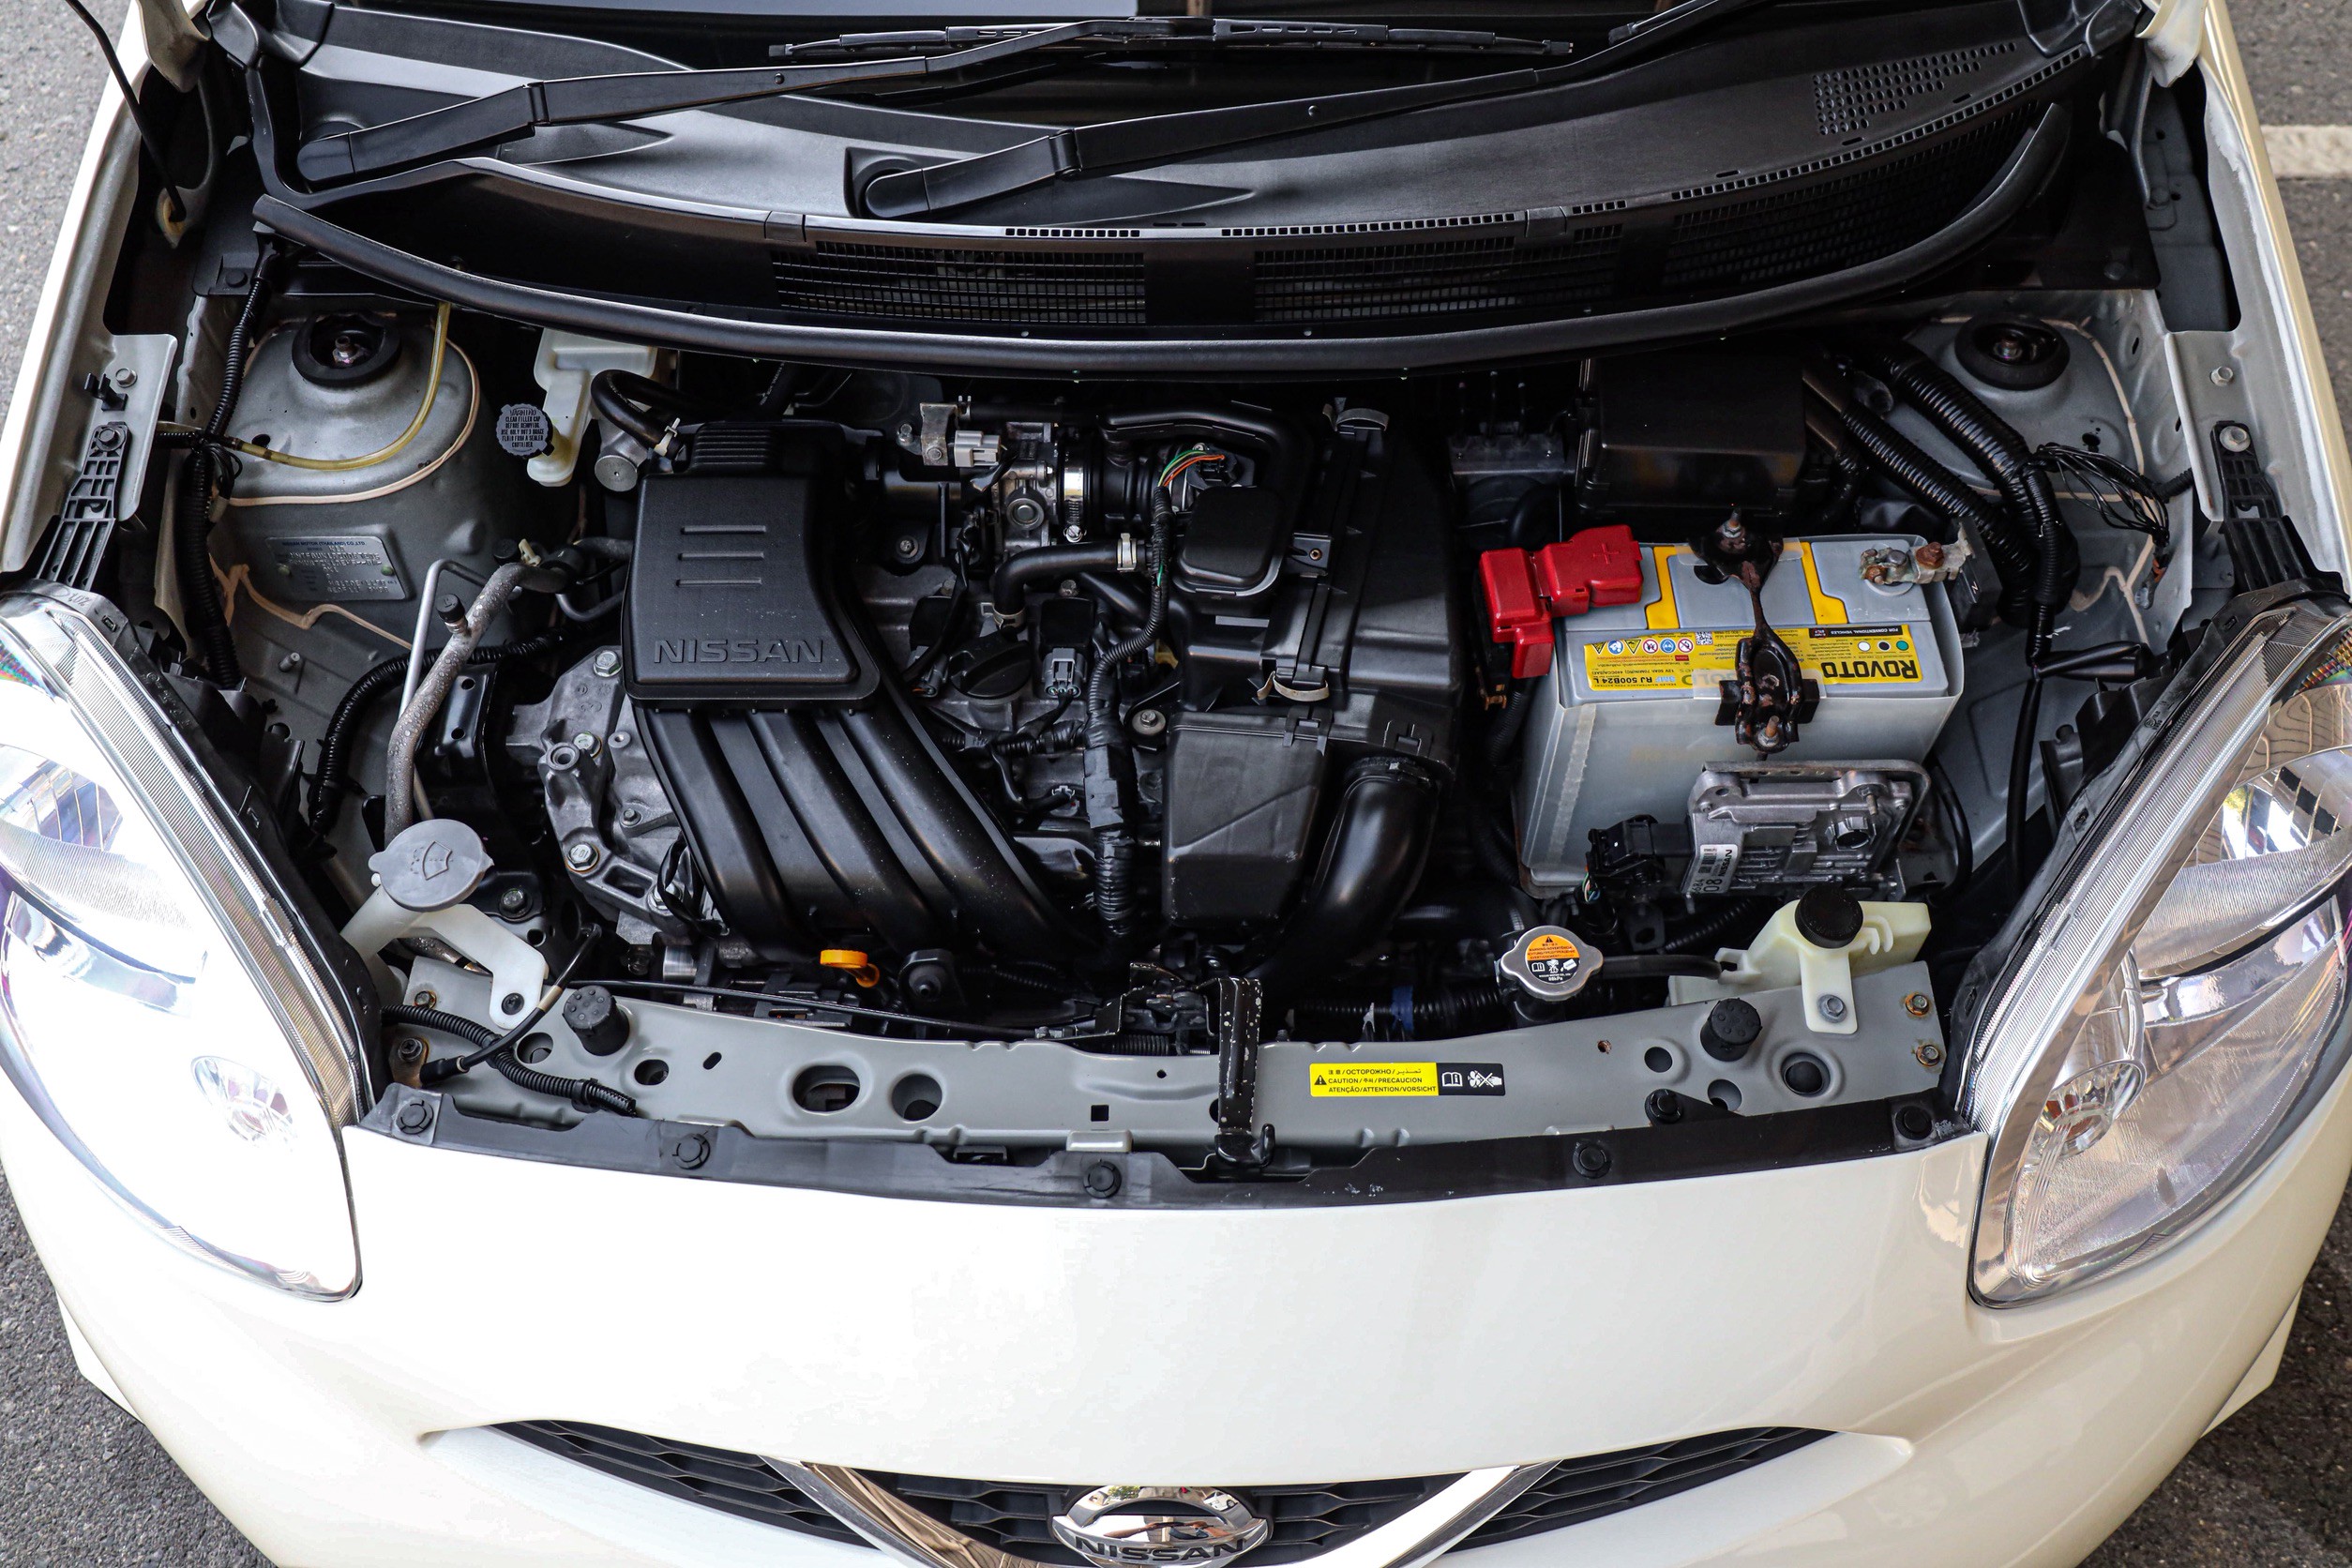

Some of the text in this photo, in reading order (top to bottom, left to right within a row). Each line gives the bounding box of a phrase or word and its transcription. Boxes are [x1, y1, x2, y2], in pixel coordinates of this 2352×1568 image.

[654, 639, 823, 663] NISSAN
[1821, 660, 1919, 678] ROVOTO
[1718, 850, 1732, 876] NISSAN
[1075, 1536, 1244, 1560] NISSAN
